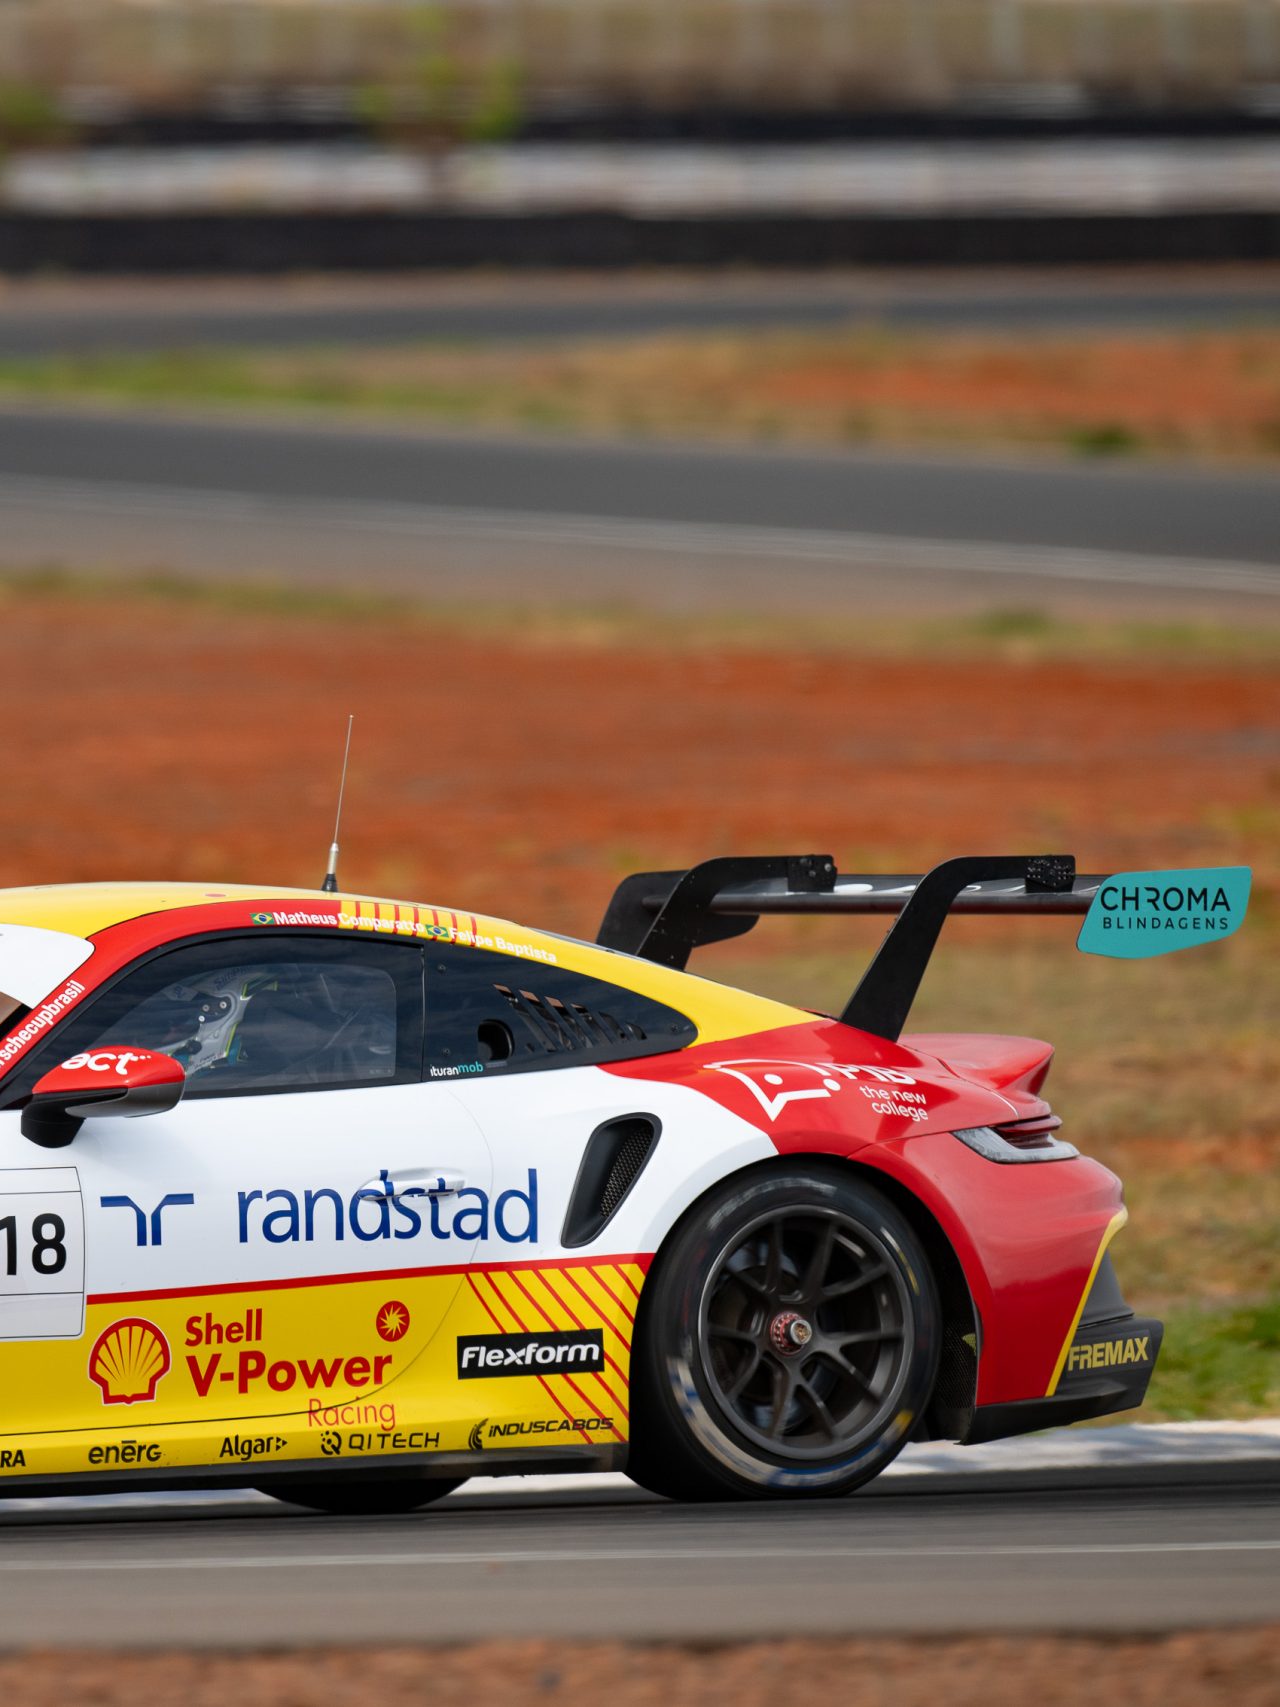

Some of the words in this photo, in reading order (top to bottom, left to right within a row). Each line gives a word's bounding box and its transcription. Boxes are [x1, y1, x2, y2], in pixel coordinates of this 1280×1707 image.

[1100, 886, 1232, 912] CHROMA
[272, 911, 338, 925] Matheus
[494, 936, 558, 963] Baptista
[1102, 917, 1229, 930] BLINDAGENS
[860, 1085, 890, 1100] the
[891, 1089, 927, 1105] new
[871, 1101, 929, 1122] college
[238, 1168, 539, 1244] randstad
[185, 1308, 263, 1348] Shell
[461, 1341, 600, 1369] Flexform
[1067, 1336, 1149, 1372] FREMAX
[185, 1354, 393, 1398] V-Power
[308, 1398, 397, 1432] Racing
[220, 1433, 274, 1462] Algar
